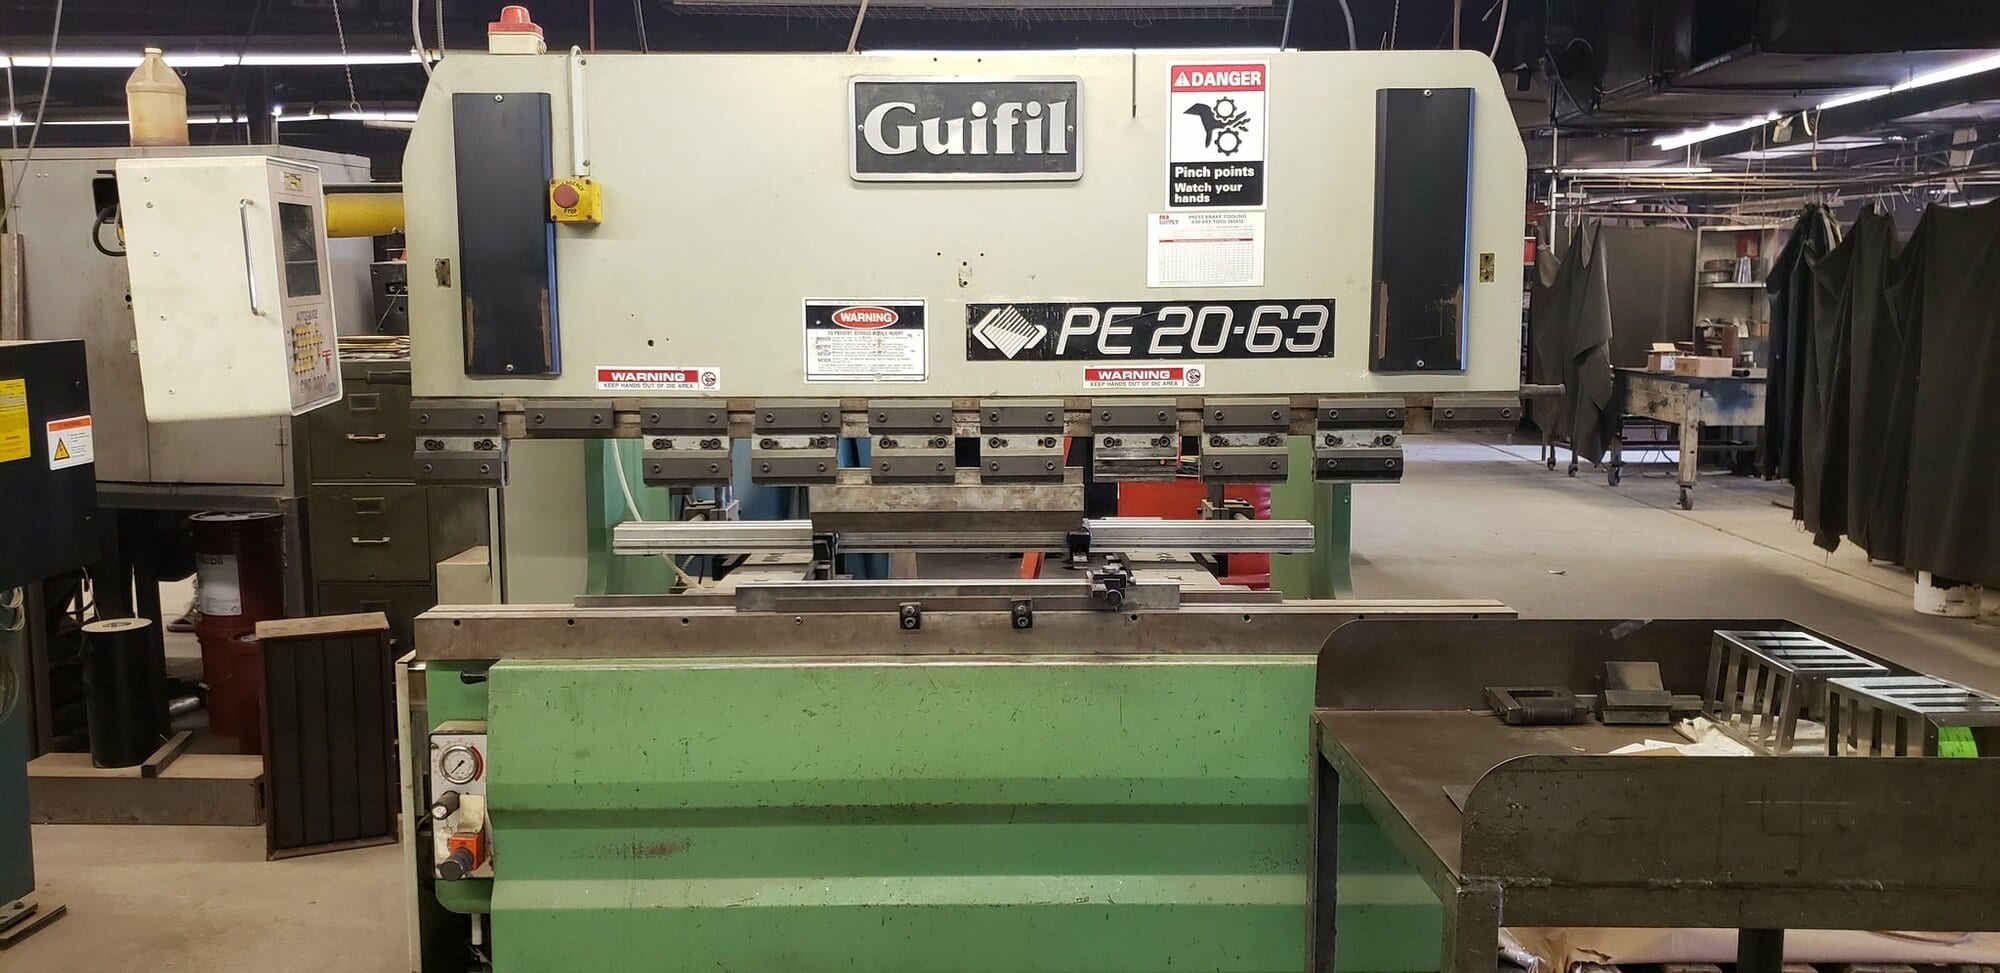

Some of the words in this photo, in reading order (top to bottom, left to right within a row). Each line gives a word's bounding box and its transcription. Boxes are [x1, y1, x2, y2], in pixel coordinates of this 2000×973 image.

[1191, 70, 1262, 87] DANGER
[863, 101, 1068, 155] Guifil
[1175, 166, 1211, 178] Pinch
[1214, 166, 1255, 179] points
[1174, 182, 1212, 193] Watch
[1215, 183, 1243, 194] your
[1174, 193, 1211, 203] hands
[839, 312, 893, 323] WARNING
[1055, 305, 1143, 355] PE
[1148, 304, 1329, 354] 20-63
[611, 372, 686, 381] WARNING
[1098, 370, 1171, 380] WARNING
